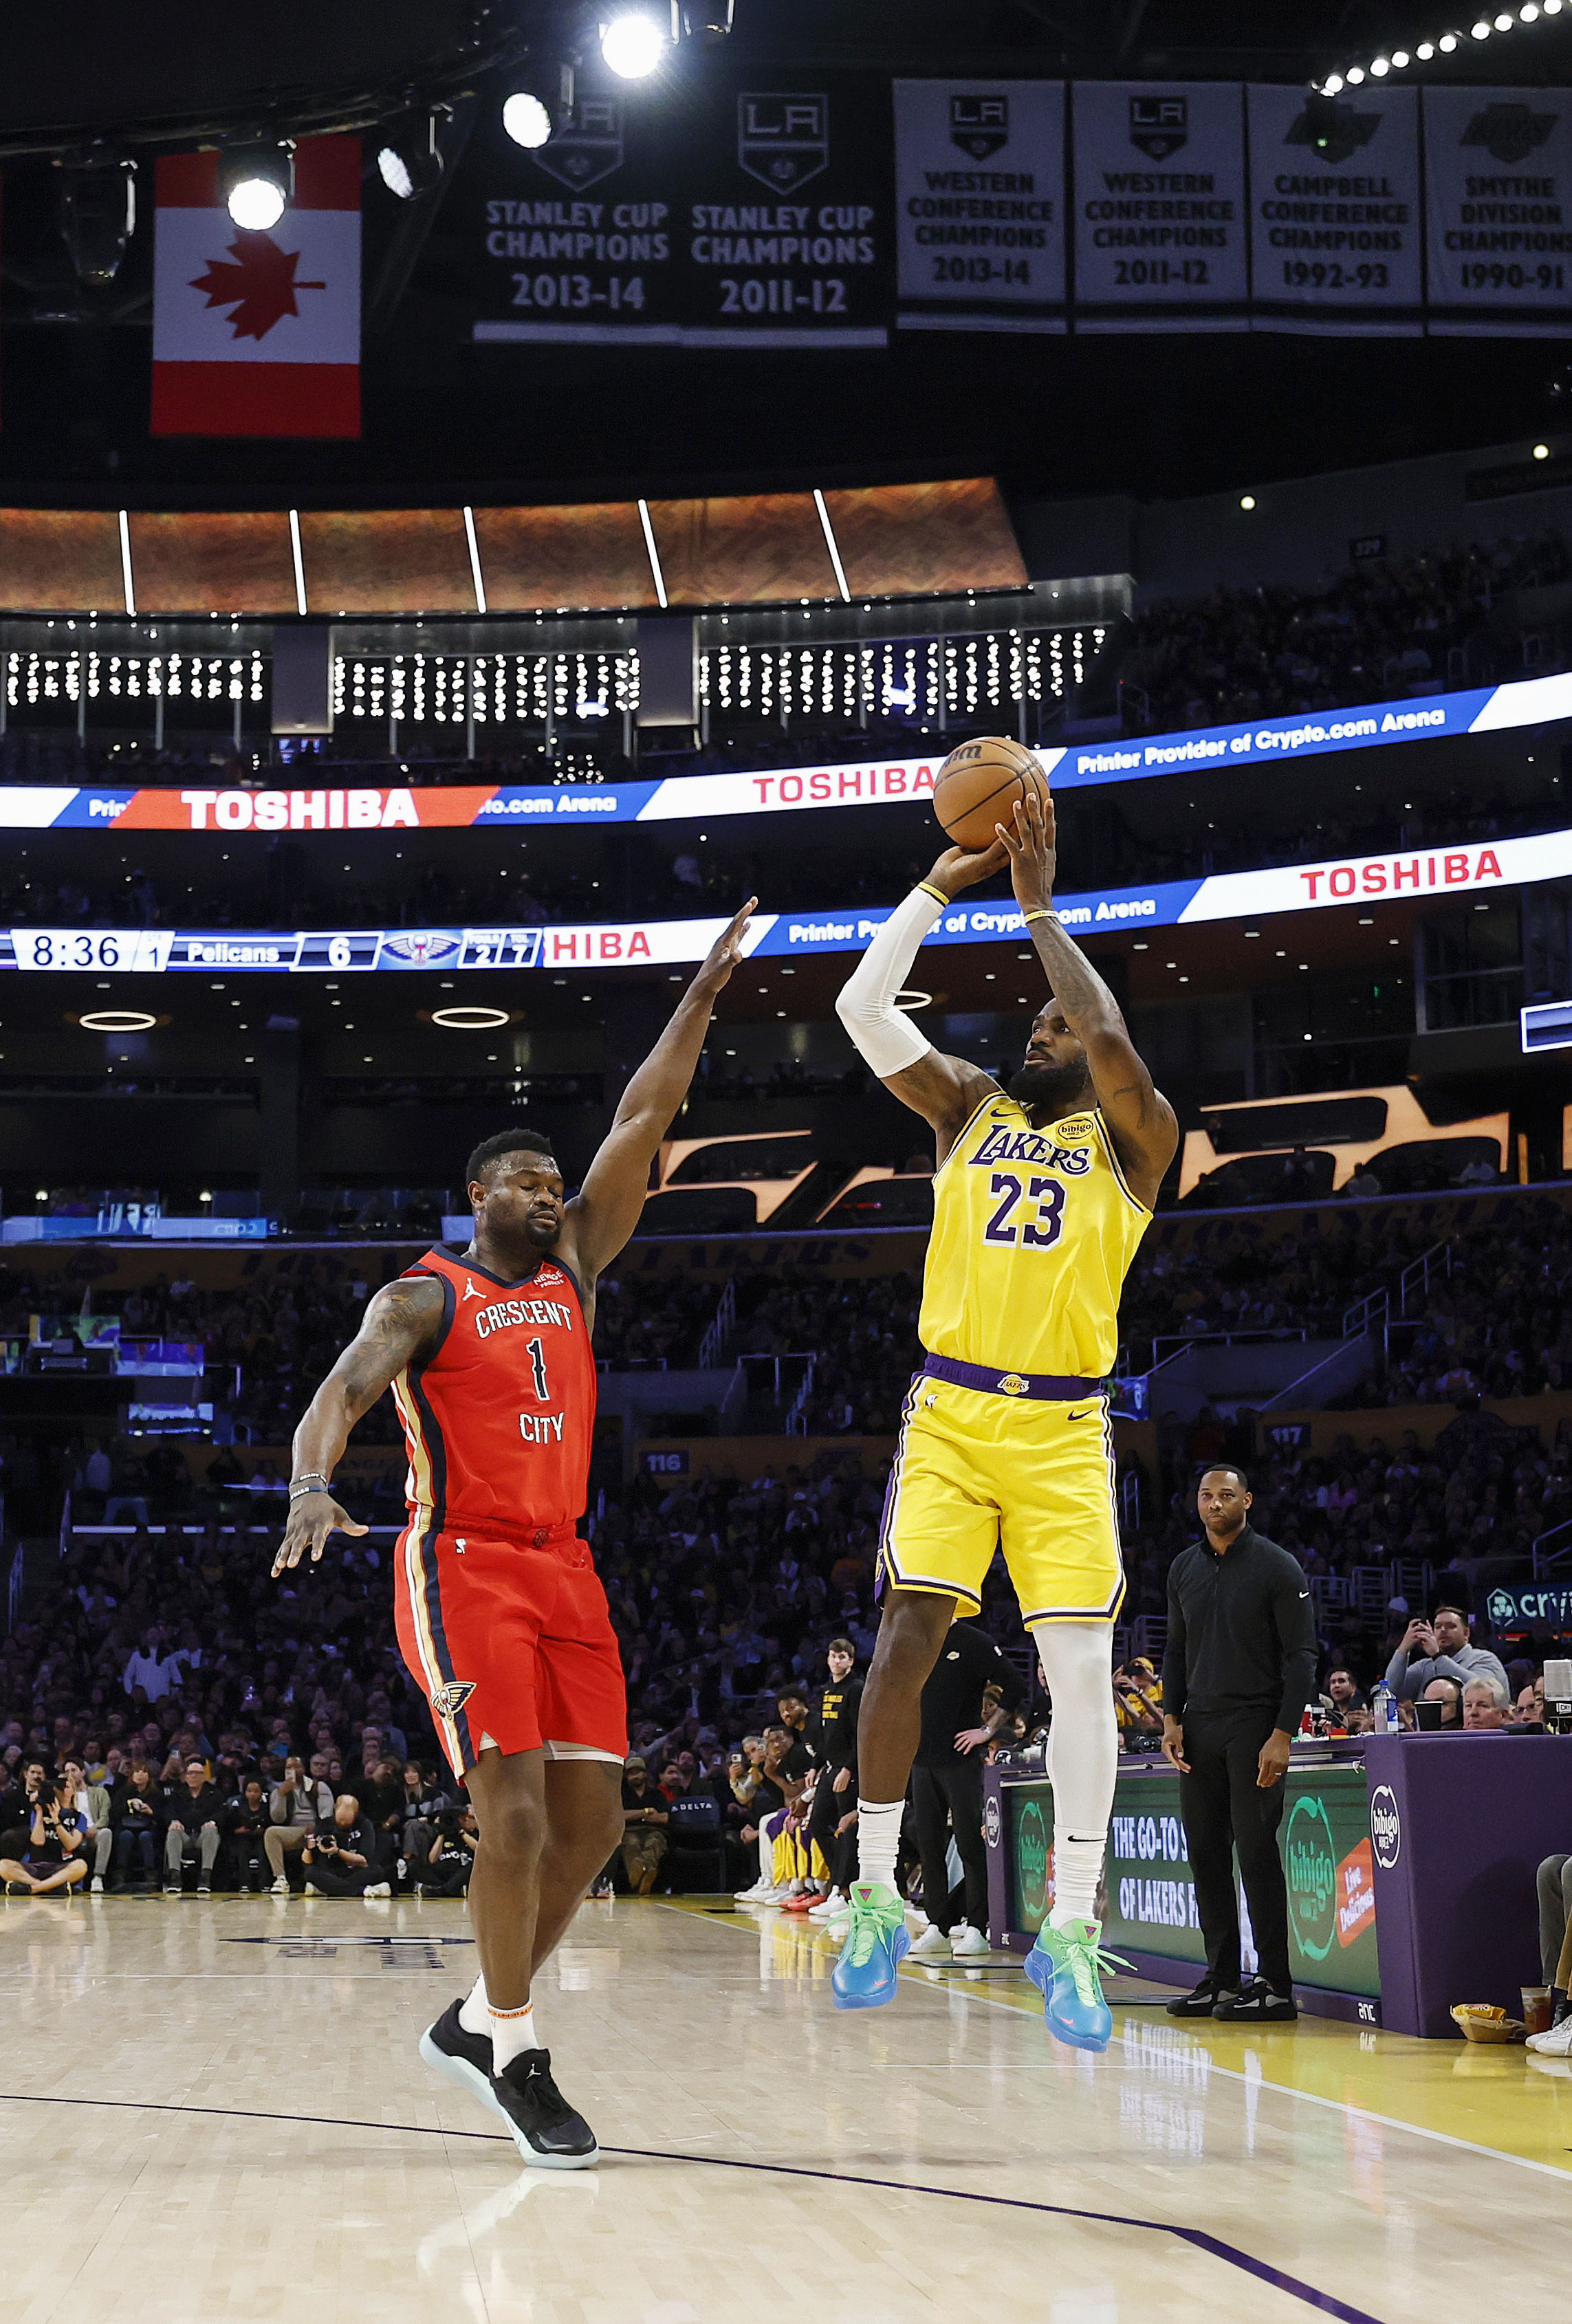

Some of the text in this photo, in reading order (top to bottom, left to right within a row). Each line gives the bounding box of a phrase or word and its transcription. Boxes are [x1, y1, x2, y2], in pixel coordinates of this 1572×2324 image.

[747, 104, 818, 134] LA
[954, 101, 1005, 122] LA
[1133, 102, 1184, 123] LA
[924, 171, 1034, 194] WESTERN
[1103, 172, 1215, 194] WESTERN
[1274, 174, 1393, 198] CAMPBELL
[1465, 175, 1555, 197] SMYTHE
[485, 200, 669, 229] STANLEY CUP
[691, 206, 875, 231] STANLEY CUP
[907, 197, 1054, 221] CONFERENCE
[1084, 200, 1234, 221] CONFERENCE
[1260, 200, 1410, 224] CONFERENCE
[1461, 204, 1562, 224] DIVISION
[485, 230, 670, 261] CHAMPIONS
[915, 224, 1047, 248] CHAMPIONS
[1092, 226, 1227, 248] CHAMPIONS
[1269, 228, 1403, 252] CHAMPIONS
[691, 236, 875, 265] CHAMPIONS
[931, 256, 1029, 285] 2013-14
[1113, 259, 1210, 285] 2011-12
[1283, 261, 1389, 289] 1992-93
[1461, 263, 1563, 289] 1990-91
[512, 274, 644, 309] 2013-14
[719, 279, 847, 314] 2011-12
[1077, 708, 1445, 776] Printer Provider of Crypto.com Arena
[753, 765, 935, 804] TOSHIBA
[89, 798, 132, 818] Prin
[181, 788, 419, 830] TOSHIBA
[556, 794, 618, 813] Arena
[1300, 848, 1503, 901] TOSHIBA
[789, 923, 855, 943] Printer
[945, 913, 968, 933] of
[1095, 899, 1157, 921] Arena
[34, 936, 118, 967] 8:36
[148, 947, 157, 967] 1
[187, 941, 280, 963] Pelicans
[328, 936, 351, 967] 6
[475, 944, 491, 963] 2
[512, 944, 529, 963] 7
[543, 930, 651, 961] HIBA
[1061, 1124, 1091, 1133] bibigo
[966, 1123, 1092, 1176] LAKERS
[982, 1171, 1068, 1253] 23
[474, 1300, 573, 1339] CRESCENT
[525, 1337, 551, 1401] 1
[518, 1412, 565, 1445] CITY
[1269, 1426, 1303, 1443] 117
[647, 1454, 681, 1471] 116
[679, 1802, 712, 1811] DELTA
[1373, 1807, 1398, 1844] bibigo
[1112, 1816, 1136, 1859] THE
[1137, 1816, 1179, 1862] GO-TO
[1289, 1840, 1333, 1912] bibigo
[1120, 1876, 1136, 1920] OF
[1137, 1878, 1187, 1928] LAKERS
